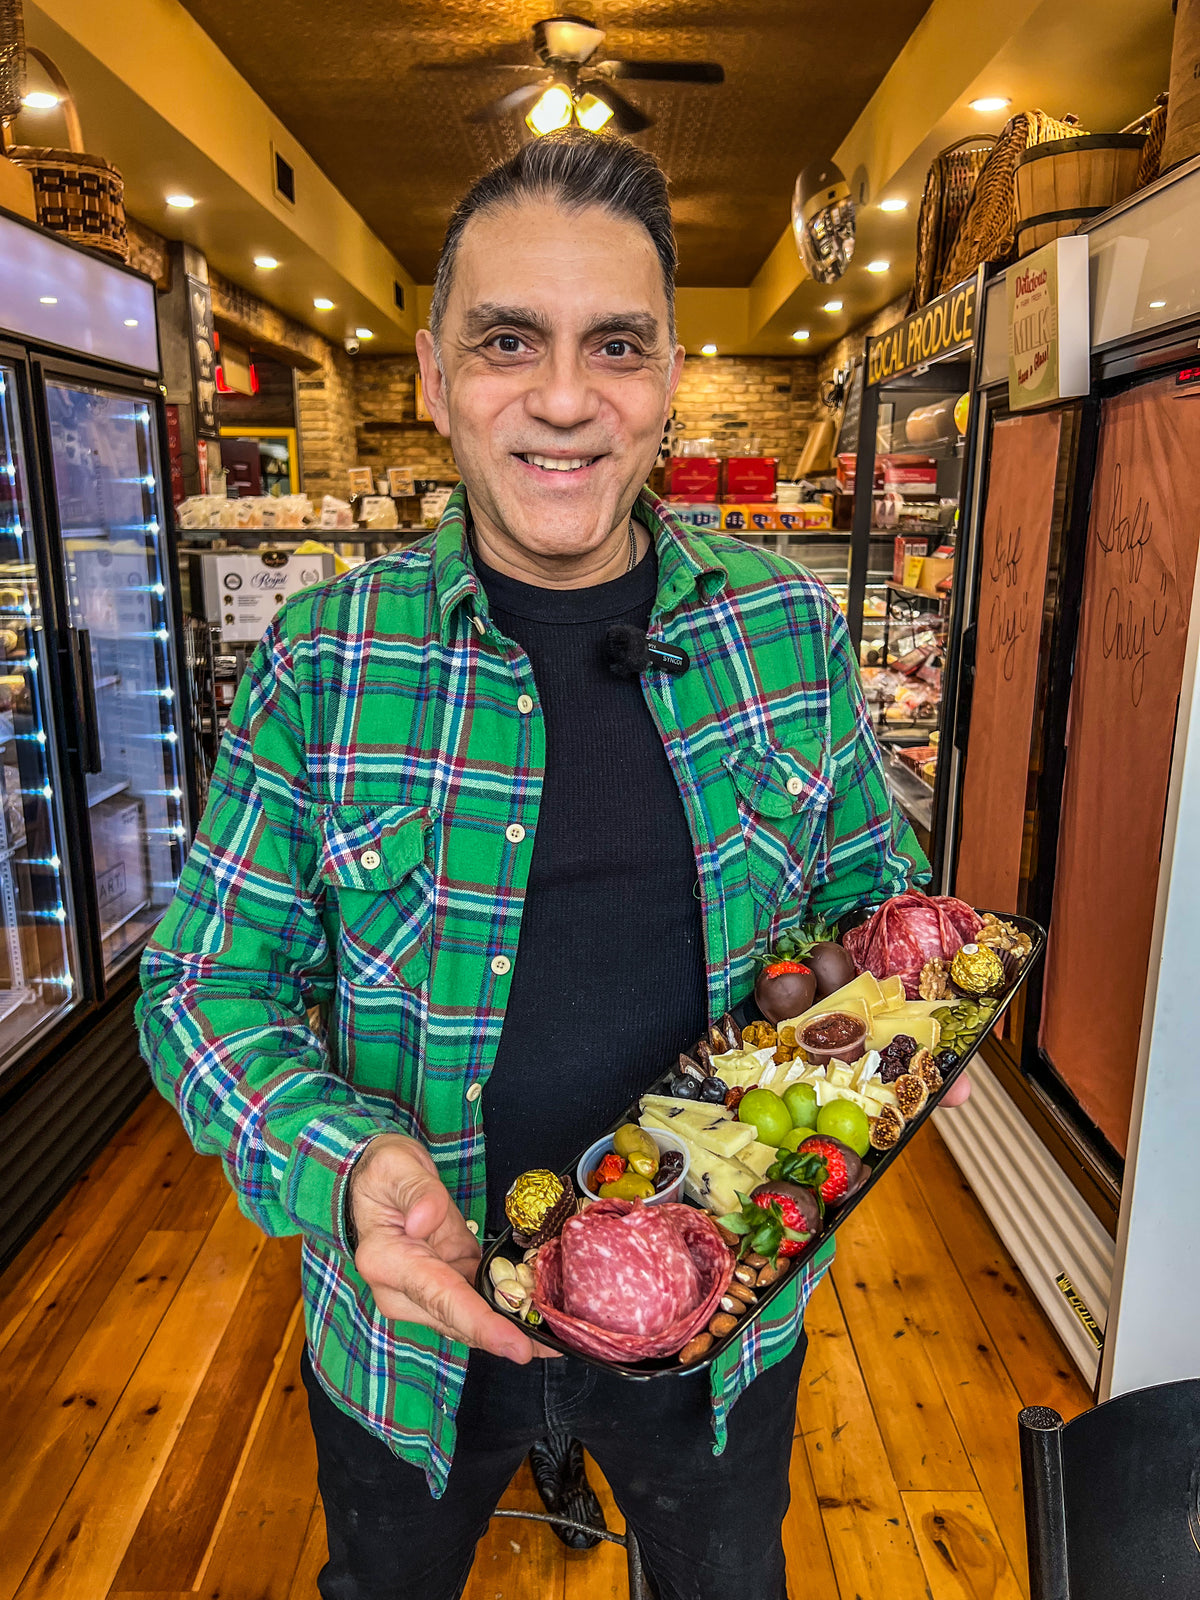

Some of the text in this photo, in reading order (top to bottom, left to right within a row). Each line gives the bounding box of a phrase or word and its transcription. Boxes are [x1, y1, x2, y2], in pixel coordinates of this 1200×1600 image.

[1013, 306, 1050, 355] MILK
[1015, 267, 1048, 299] Delicious
[867, 284, 975, 386] LOCAL PRODUCE
[1096, 462, 1153, 584] Staff
[1102, 587, 1151, 708] Only
